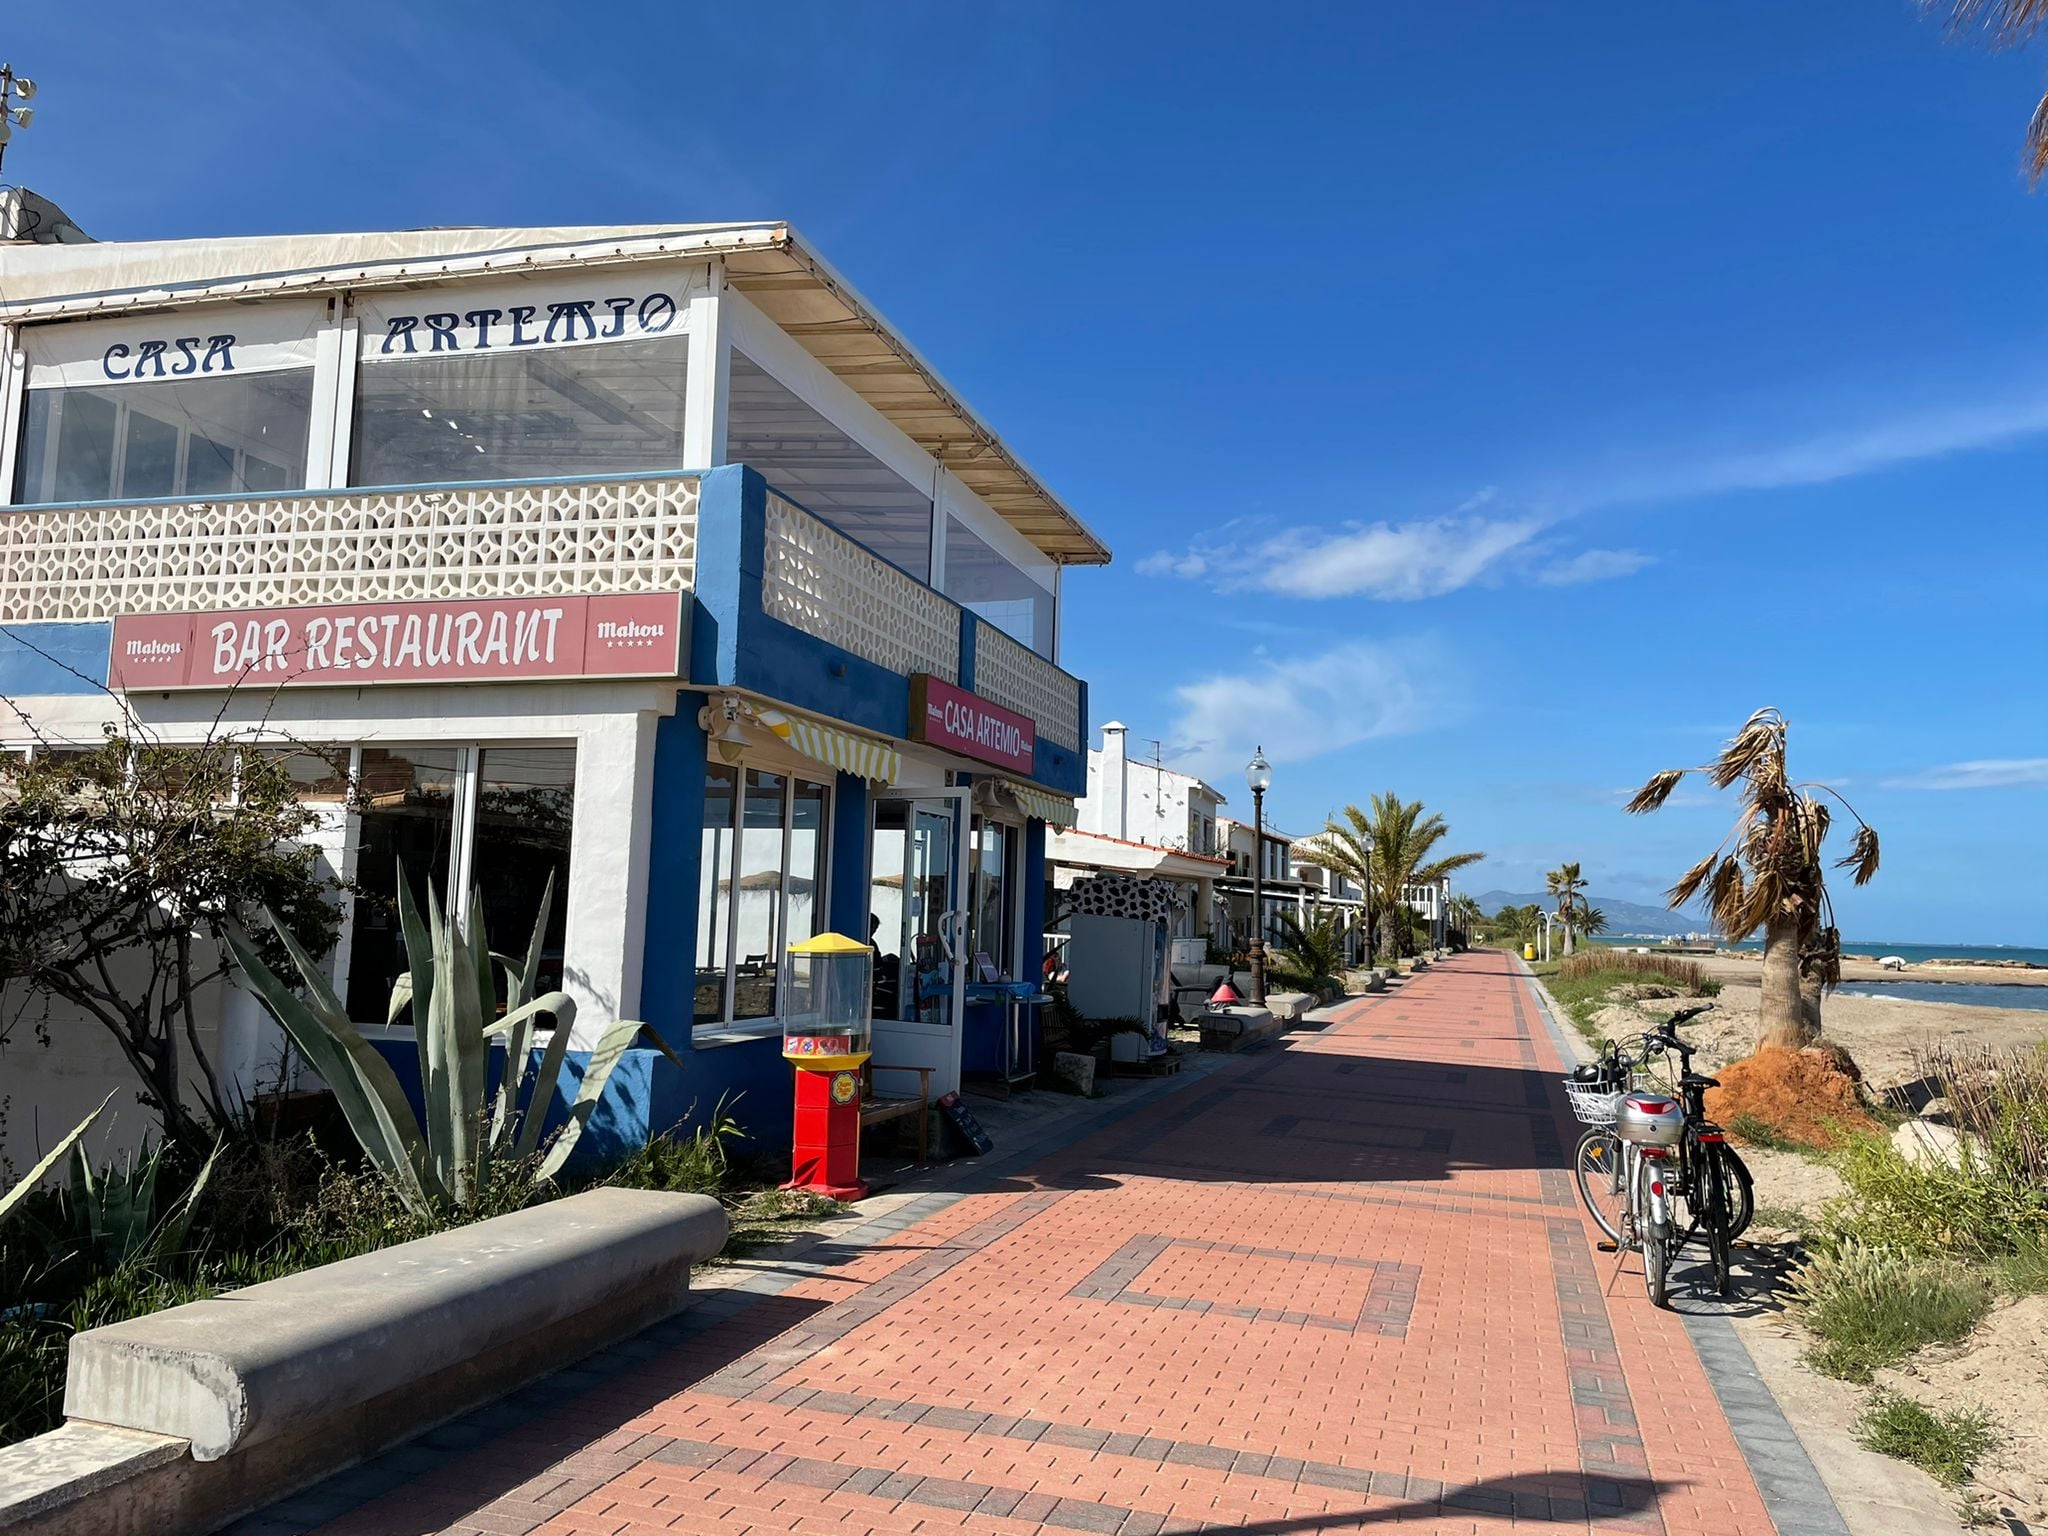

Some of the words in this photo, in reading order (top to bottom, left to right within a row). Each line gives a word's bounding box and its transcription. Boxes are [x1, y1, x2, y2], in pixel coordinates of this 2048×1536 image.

[103, 335, 236, 380] CASA
[126, 640, 181, 655] Mahou
[211, 618, 291, 674] BAR
[305, 608, 563, 669] RESTAURANT
[597, 618, 665, 639] Mahou
[944, 700, 975, 740] CASA
[976, 713, 1020, 757] ARTEMIO
